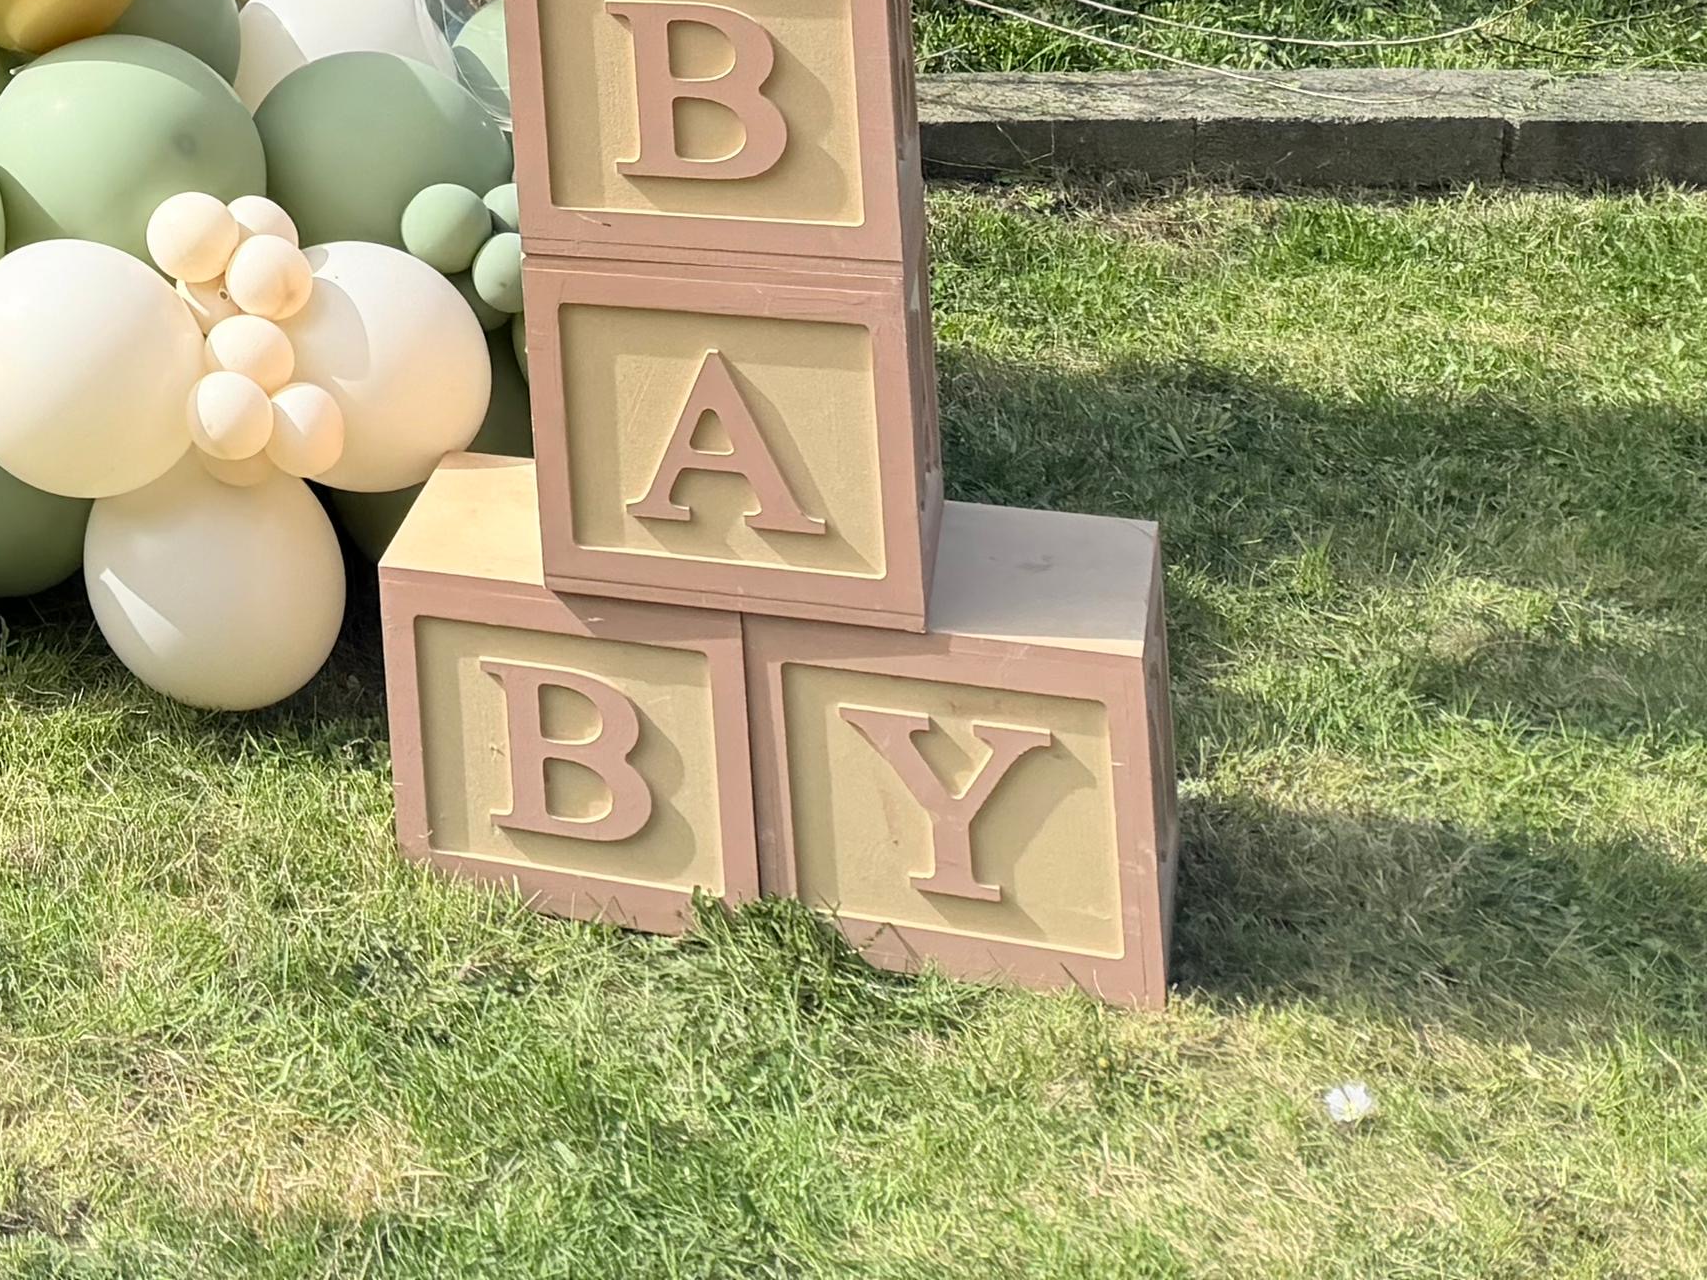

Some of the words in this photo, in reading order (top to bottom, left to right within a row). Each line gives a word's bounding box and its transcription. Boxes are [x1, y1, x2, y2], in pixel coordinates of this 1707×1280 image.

[625, 347, 827, 536] A
[478, 656, 654, 843] B
[836, 702, 1053, 905] Y
